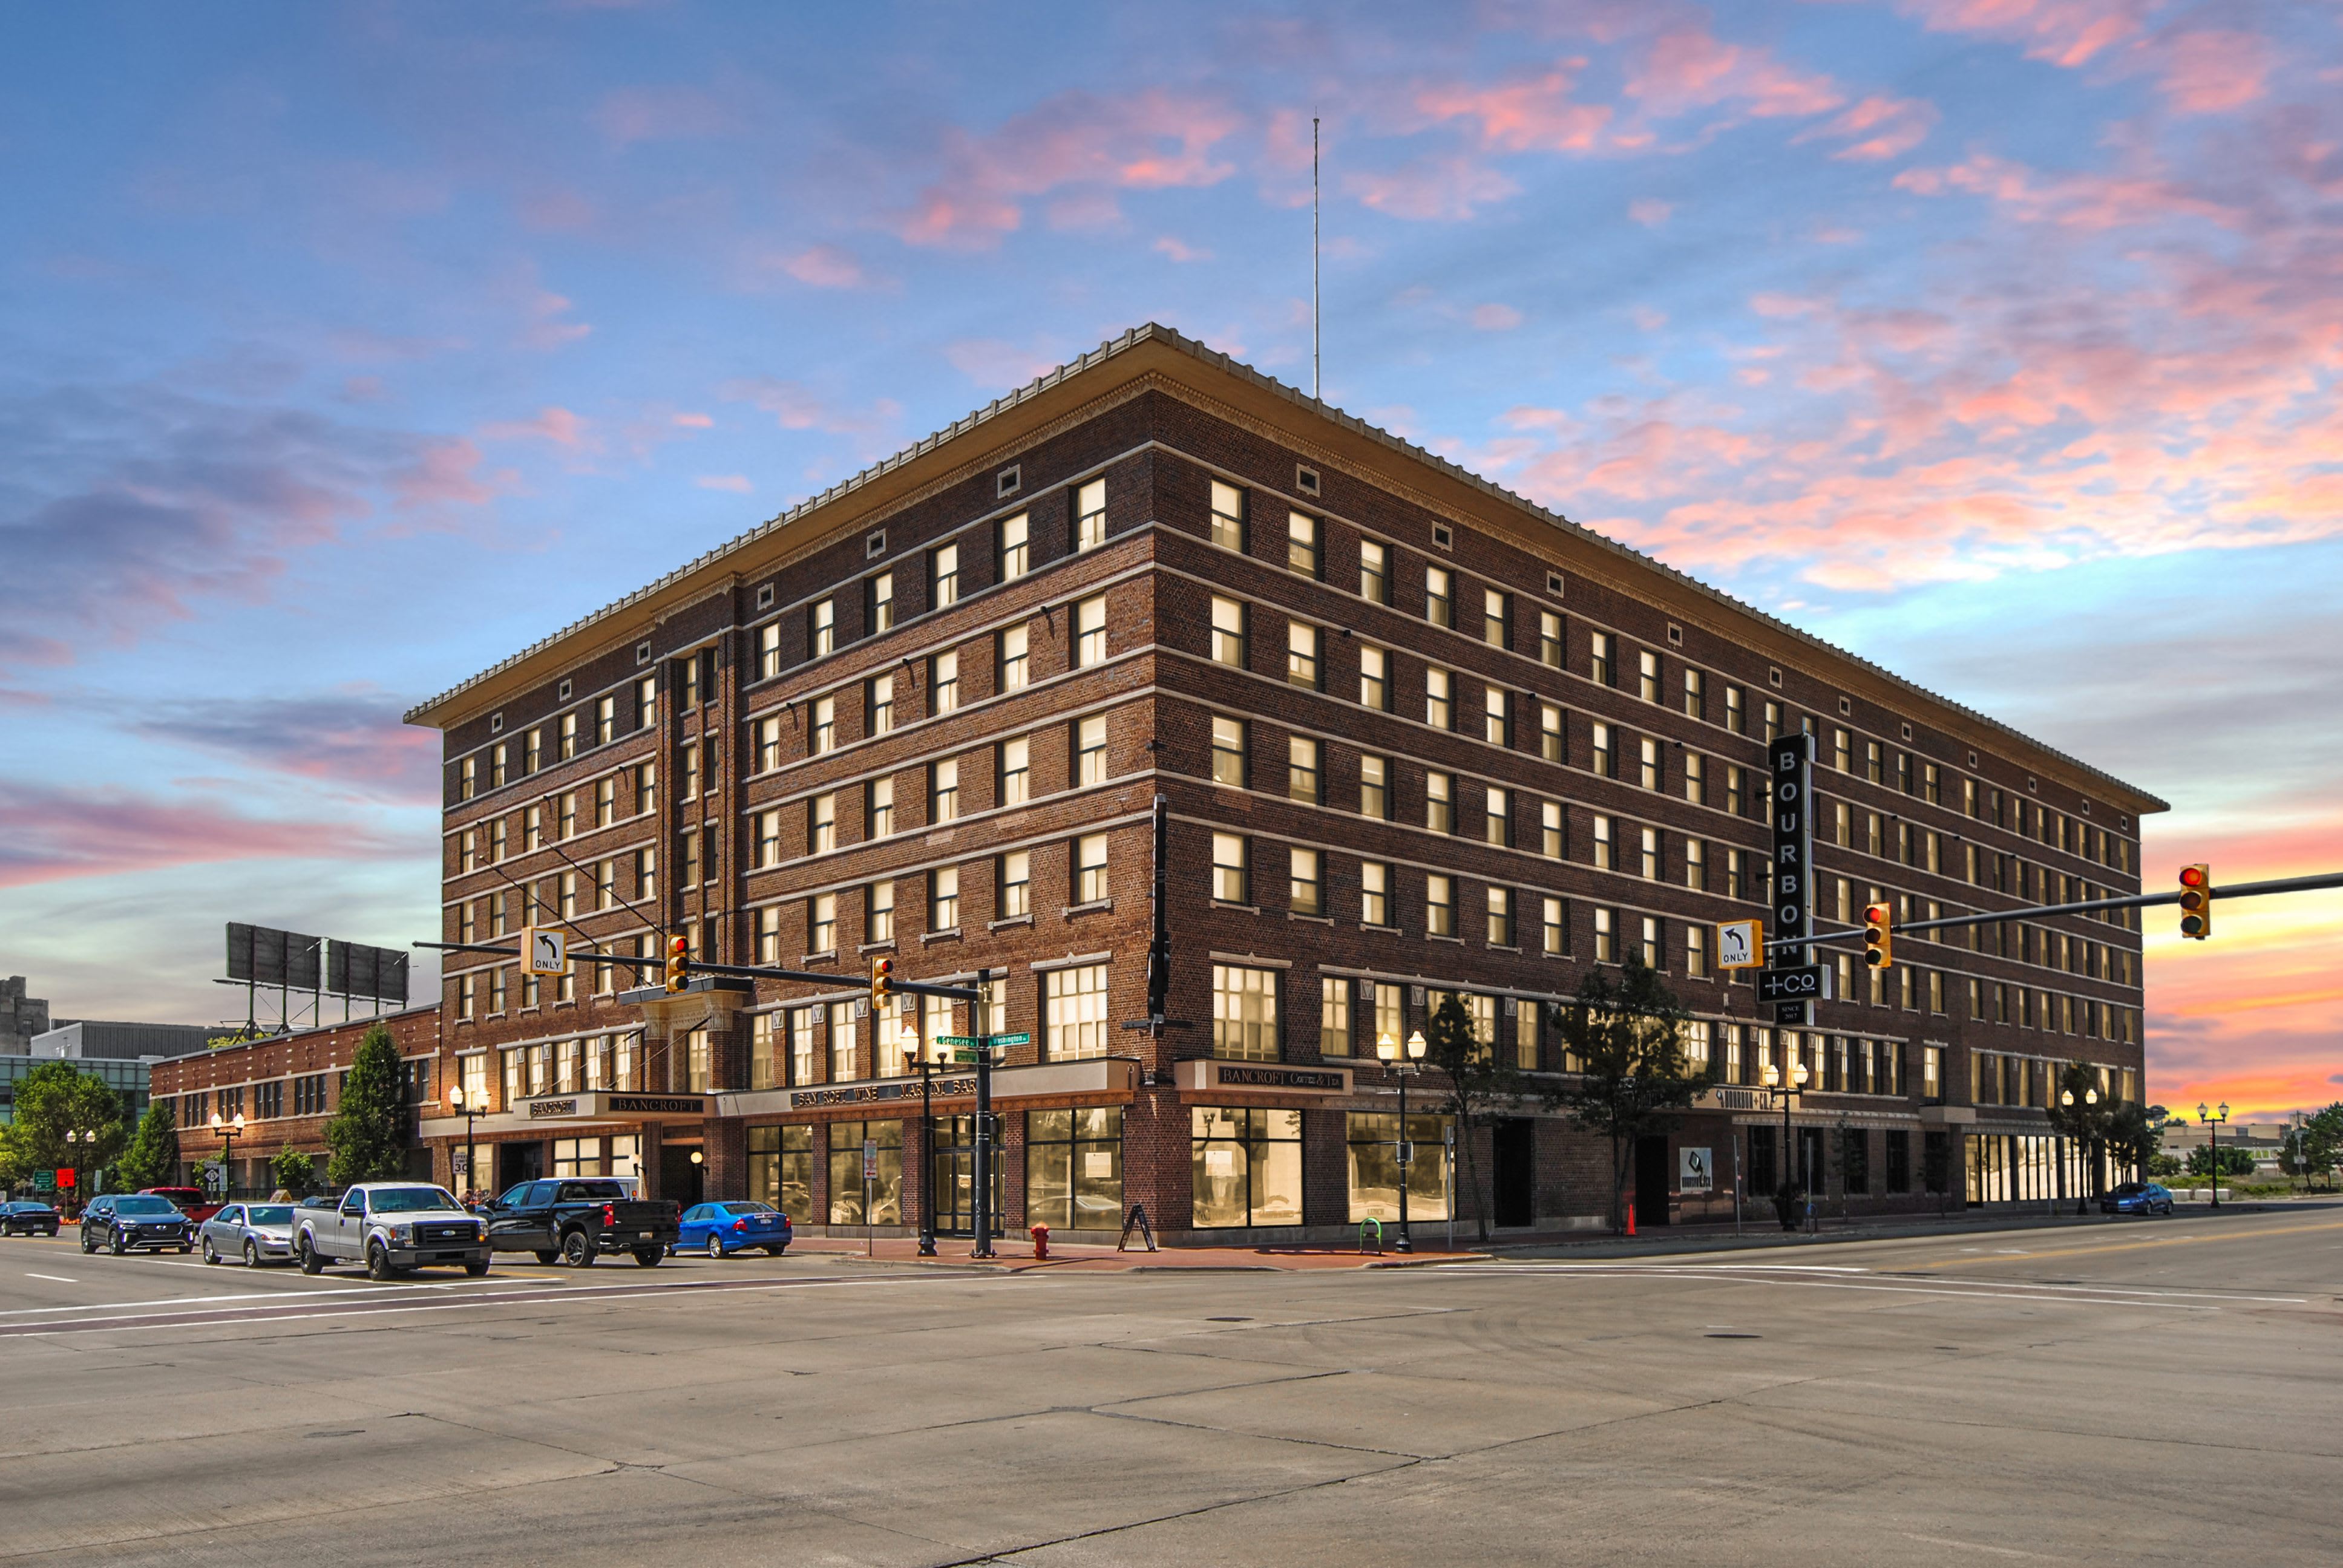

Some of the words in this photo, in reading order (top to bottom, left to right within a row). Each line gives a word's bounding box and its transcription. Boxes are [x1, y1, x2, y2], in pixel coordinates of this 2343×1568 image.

[1780, 752, 1798, 955] BOURBON
[1723, 952, 1748, 963] ONLY
[536, 959, 560, 970] ONLY
[942, 1036, 969, 1046] Genesee
[993, 1035, 1023, 1044] Washington
[1224, 1069, 1286, 1085] BANCROFT
[854, 1086, 878, 1101] WINE
[900, 1082, 946, 1099] MARINI
[953, 1079, 978, 1093] BAR
[618, 1099, 695, 1111] BANCROFT
[1725, 1090, 1753, 1109] BOURBON
[534, 1101, 572, 1114] BANCROFT
[455, 1163, 467, 1172] 30
